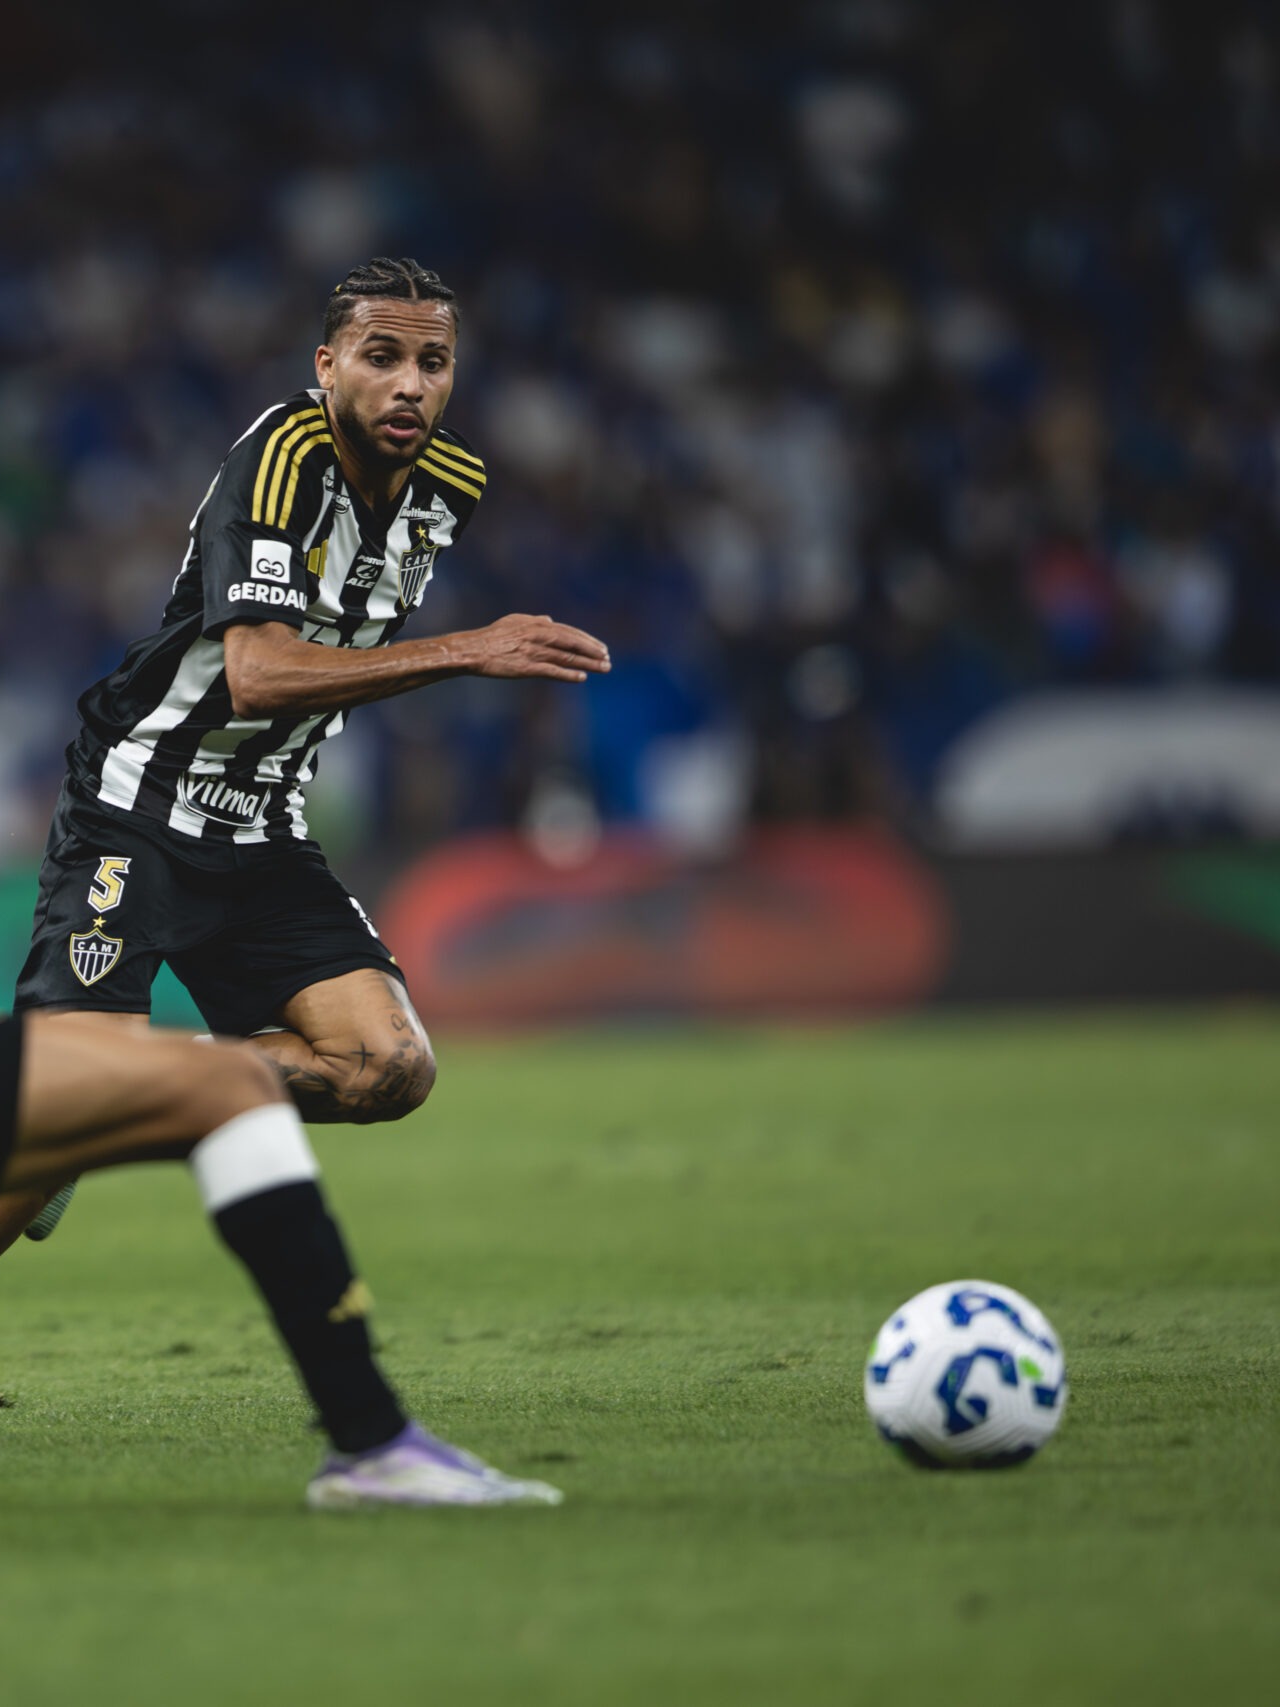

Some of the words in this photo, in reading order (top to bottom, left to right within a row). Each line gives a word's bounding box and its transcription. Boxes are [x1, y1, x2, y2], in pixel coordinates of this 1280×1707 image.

[405, 553, 431, 568] CAM
[345, 577, 376, 589] ALE
[227, 581, 308, 612] GERDAU
[186, 773, 259, 818] Vilma
[87, 856, 132, 913] 5
[77, 941, 113, 953] CAM
